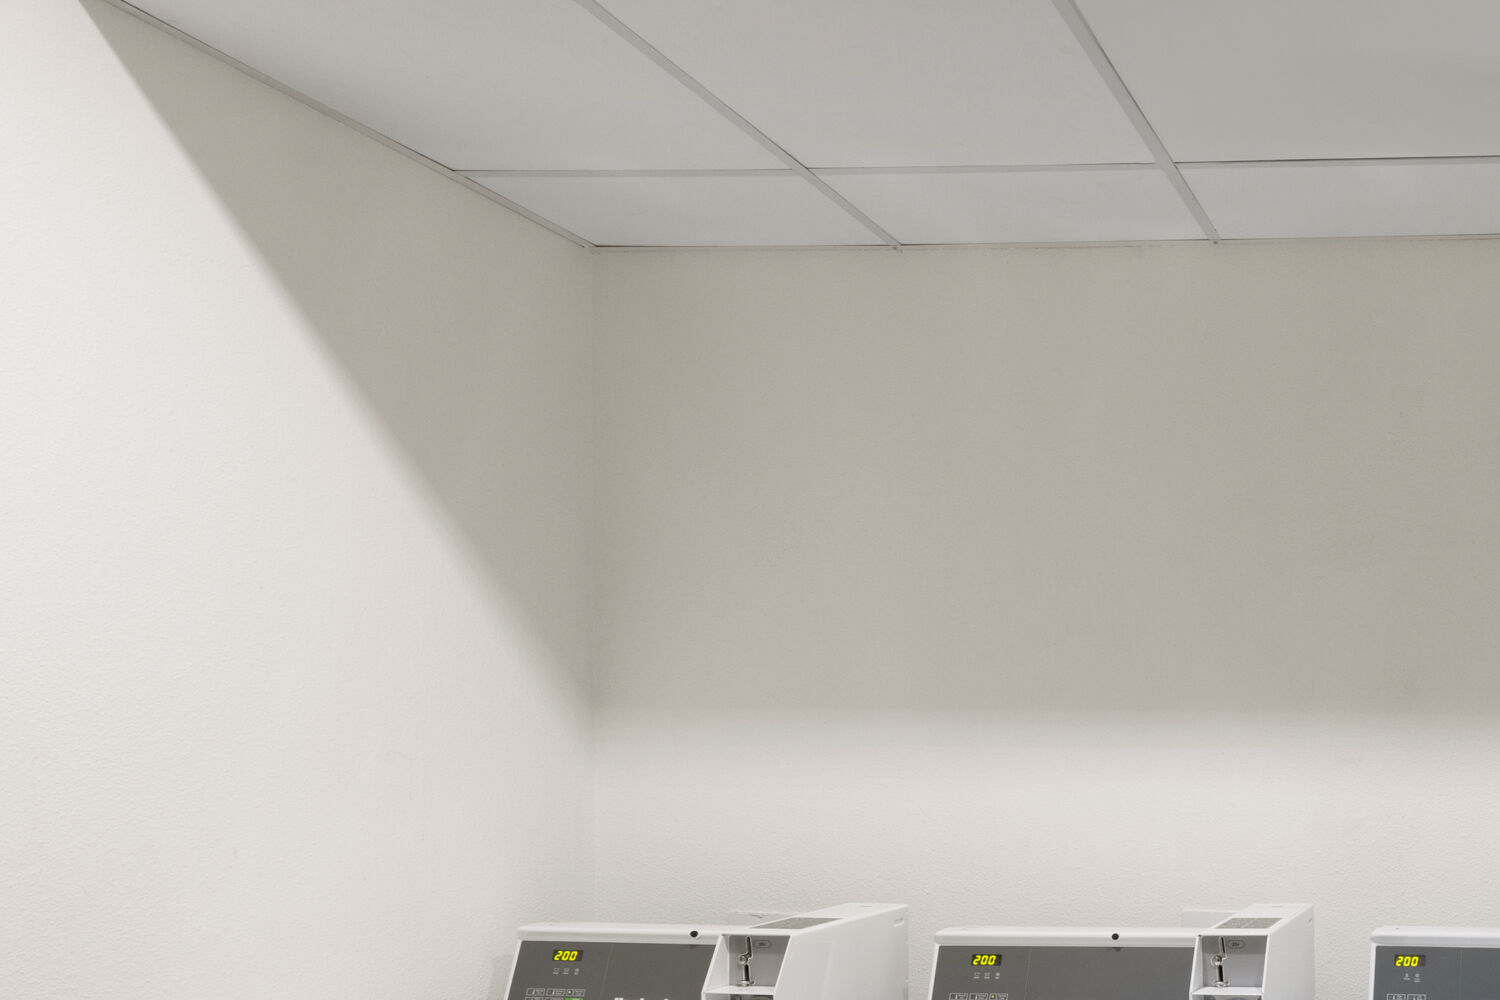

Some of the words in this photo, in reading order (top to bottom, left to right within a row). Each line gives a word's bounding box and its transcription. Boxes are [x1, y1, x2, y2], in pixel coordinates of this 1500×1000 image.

[553, 950, 578, 961] 200
[972, 954, 997, 966] 200
[1395, 955, 1420, 967] 200
